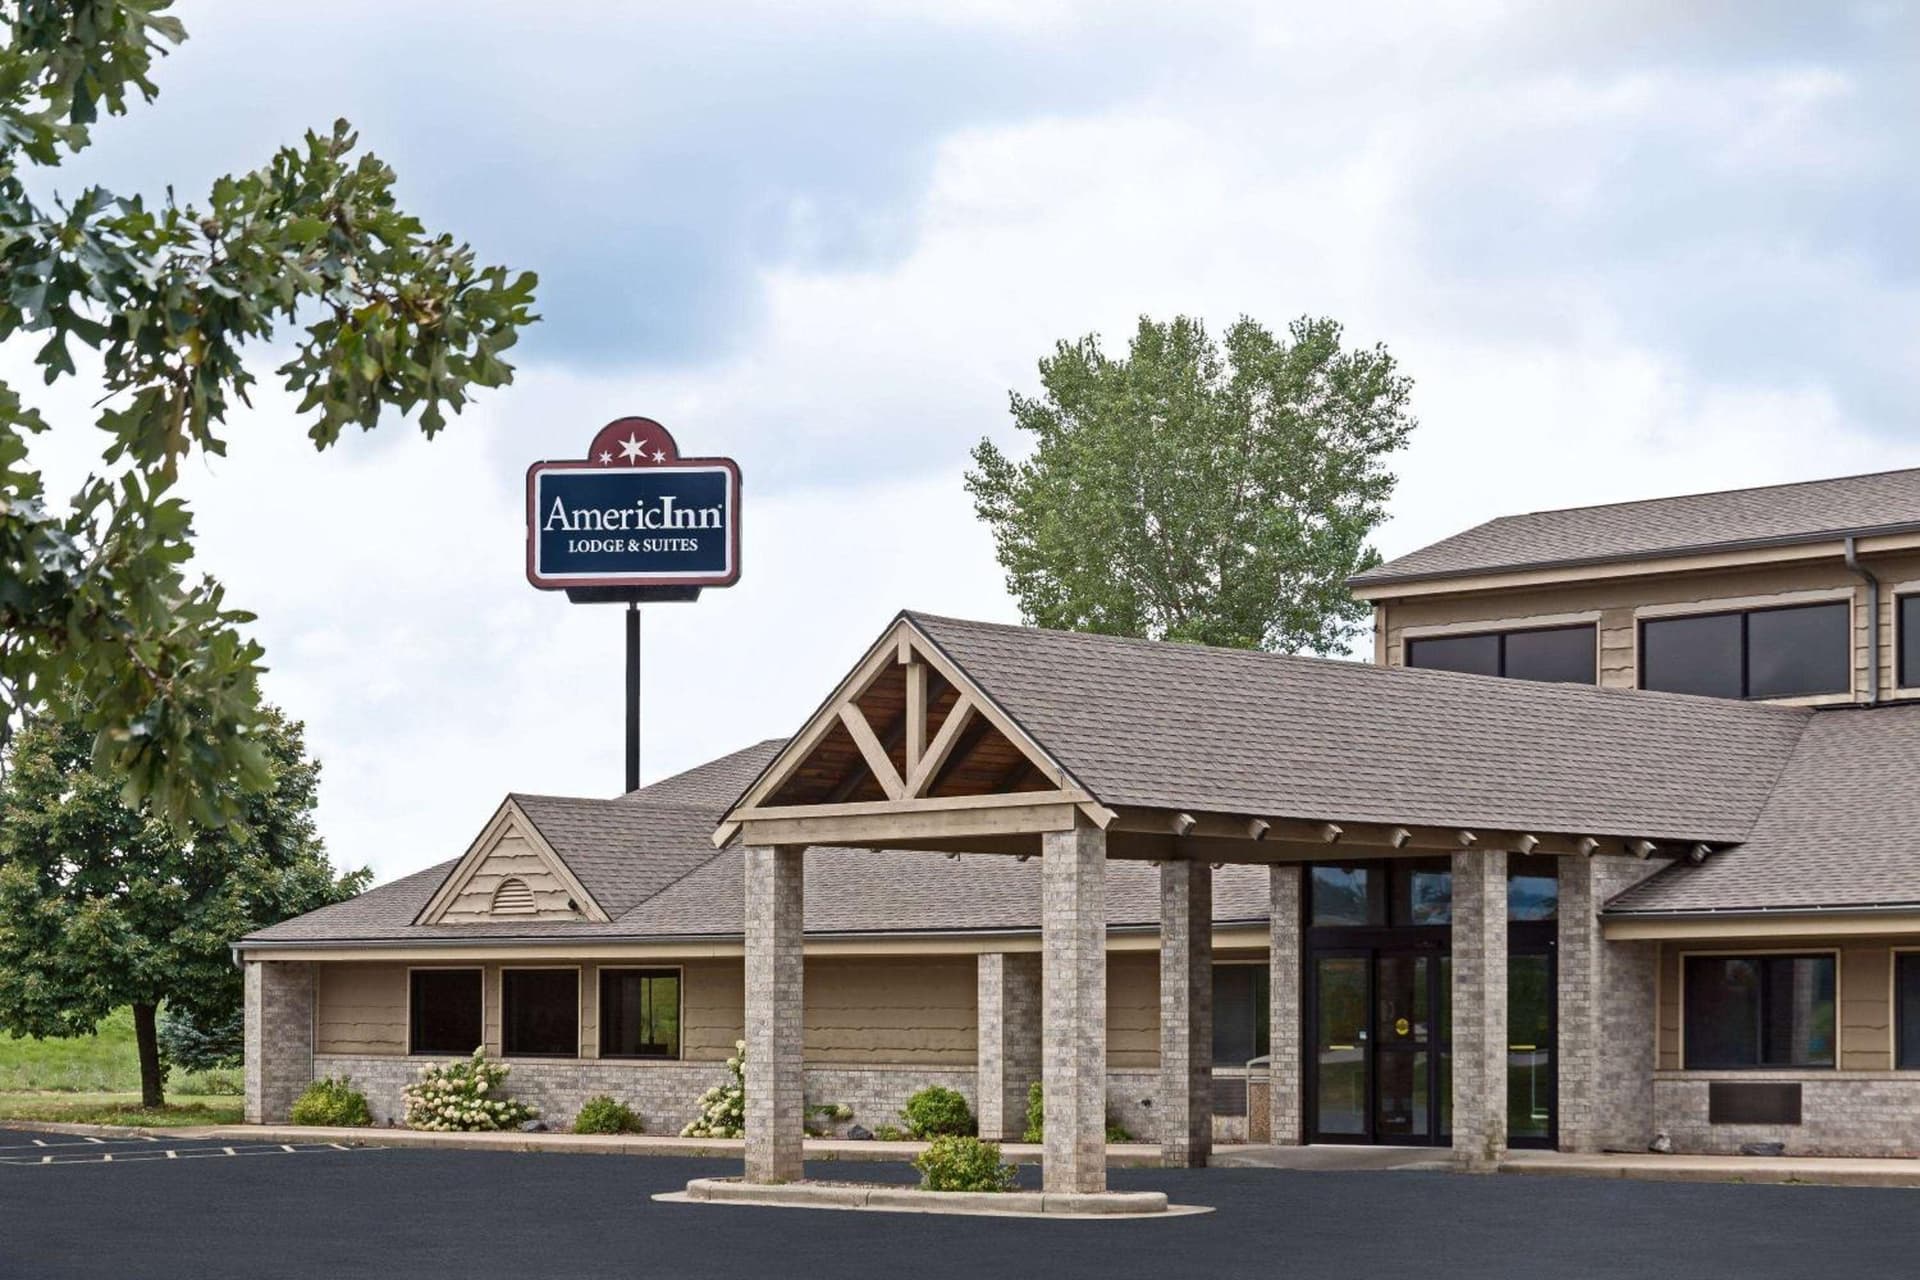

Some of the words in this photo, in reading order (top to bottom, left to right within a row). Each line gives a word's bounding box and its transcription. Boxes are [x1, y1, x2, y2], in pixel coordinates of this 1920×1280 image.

[543, 496, 722, 531] AmericInn
[568, 540, 624, 553] LODGE
[628, 539, 640, 552] &
[643, 538, 698, 552] SUITES
